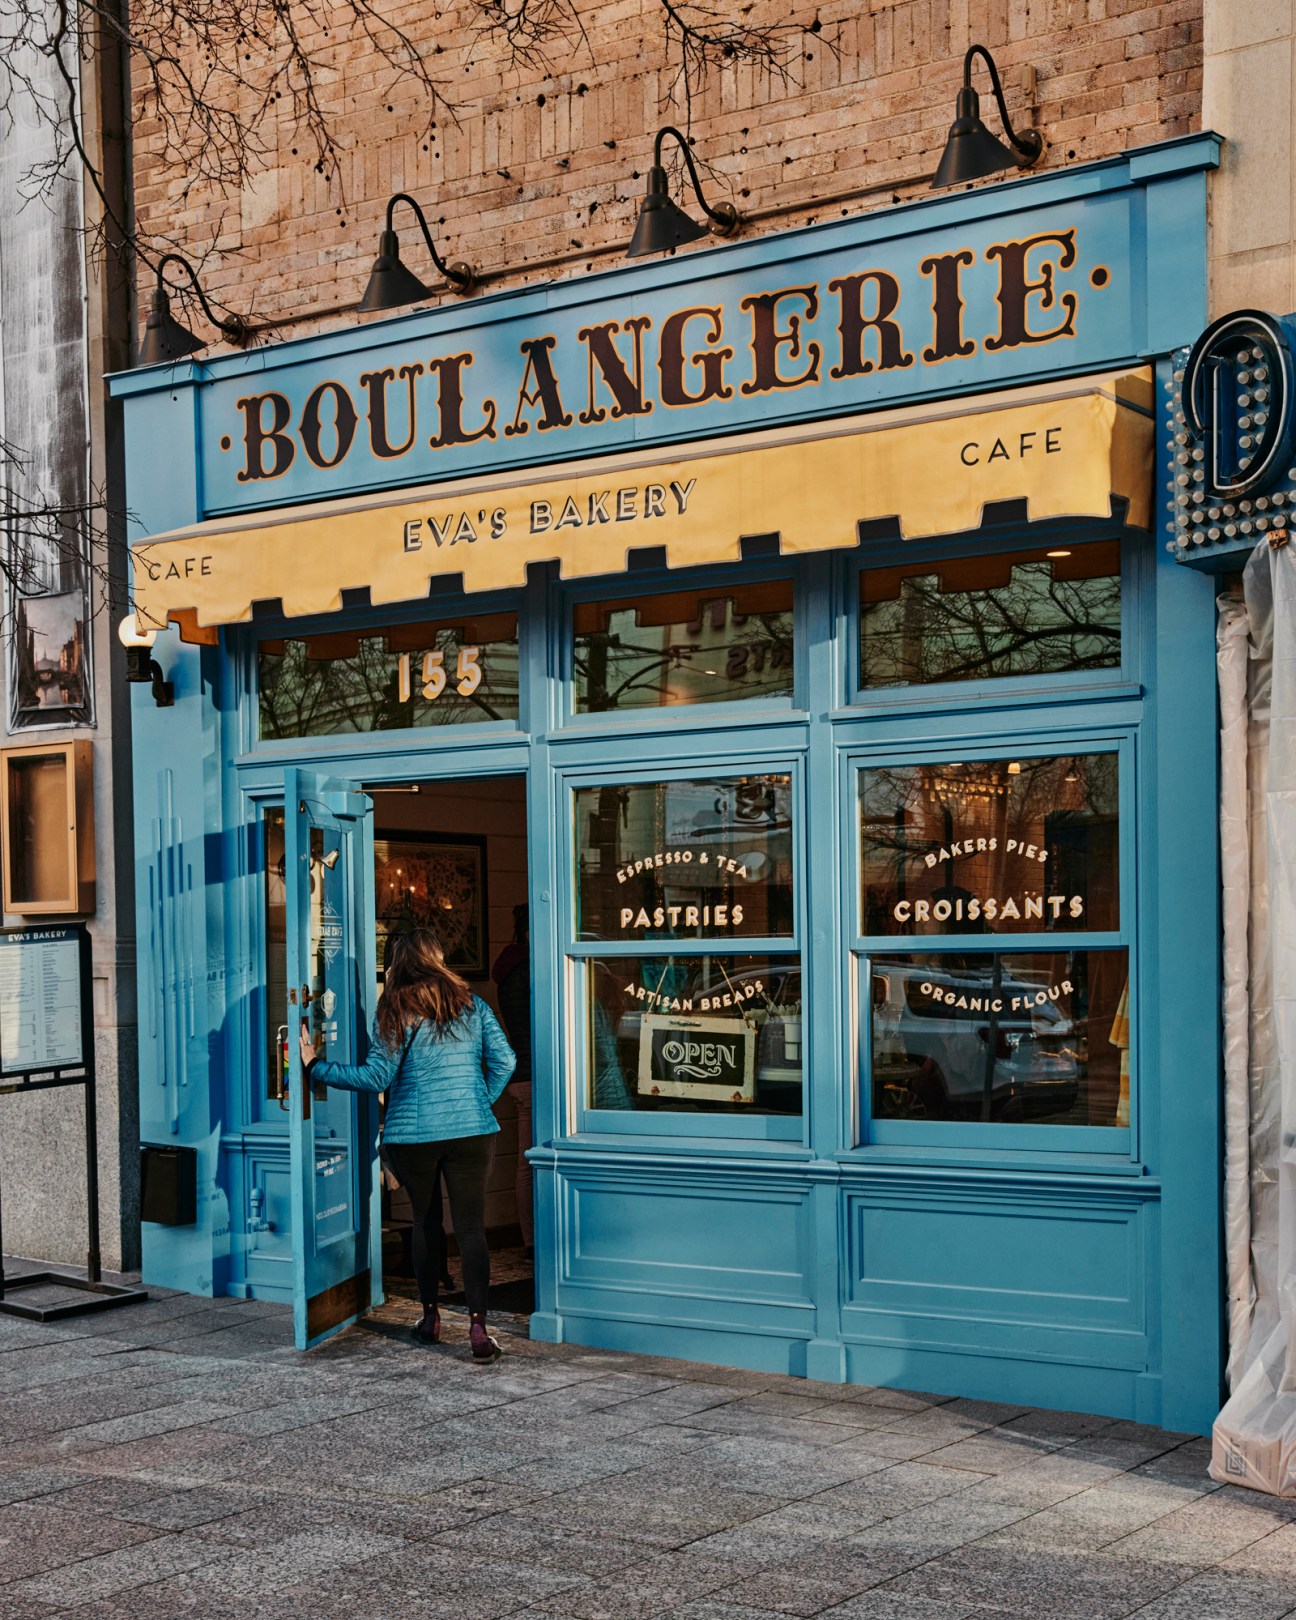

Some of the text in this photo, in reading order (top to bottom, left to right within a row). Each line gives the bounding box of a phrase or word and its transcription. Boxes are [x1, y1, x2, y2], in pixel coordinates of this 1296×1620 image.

[237, 227, 1078, 481] BOULANGERIE
[960, 427, 1063, 467] CAFE
[403, 478, 698, 552] EVA'S BAKERY
[148, 555, 213, 581] CAFE
[398, 646, 482, 704] 155
[616, 850, 748, 884] ESPRESSO & TEA
[924, 837, 1049, 869] BAKERS PIES
[620, 904, 744, 929] PASTRIES
[893, 895, 1084, 922] CROISSANTS
[8, 930, 67, 942] EVA'S BAKERY
[623, 980, 764, 1011] ARTISAN BREADS
[919, 980, 1075, 1012] ORGANIC FLOUR
[662, 1040, 737, 1070] OPEN
